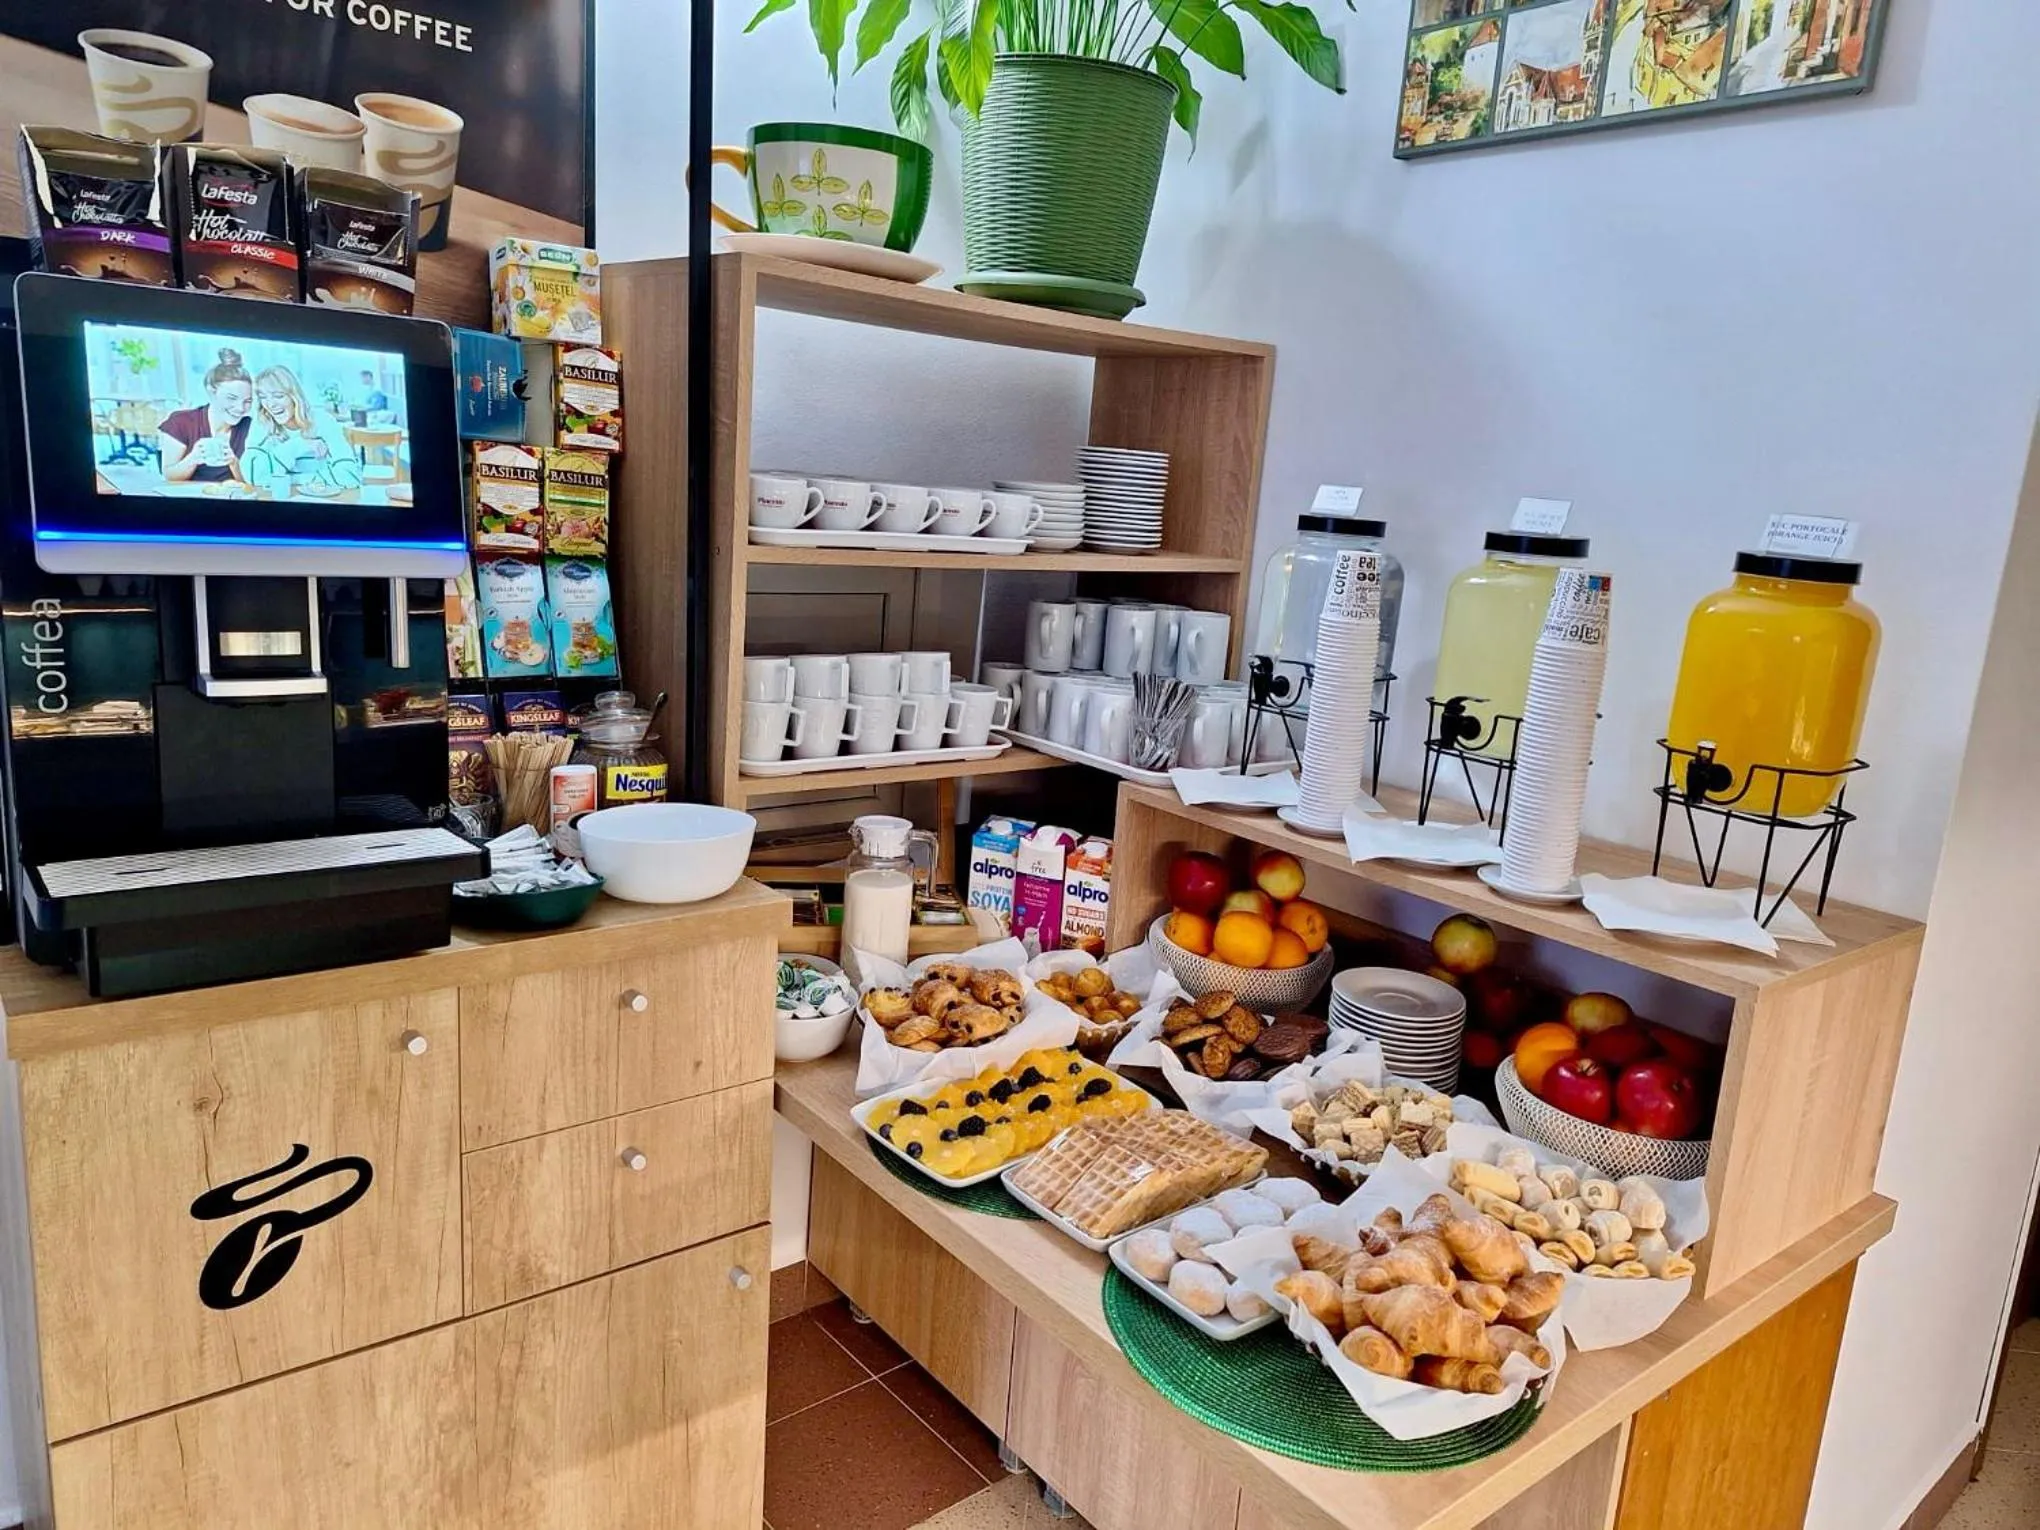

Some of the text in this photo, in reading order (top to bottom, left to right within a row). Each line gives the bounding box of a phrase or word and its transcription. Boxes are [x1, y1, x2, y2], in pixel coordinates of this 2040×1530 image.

[347, 0, 473, 52] COFFEE
[202, 184, 258, 205] LaFesta
[193, 209, 248, 231] Hot
[101, 230, 137, 244] DARK
[230, 244, 276, 260] CLASSIC
[565, 366, 617, 384] BASILUR
[481, 464, 538, 481] BASILUR
[550, 470, 604, 487] BASILUR
[1334, 554, 1351, 595] coffee
[21, 598, 69, 714] coffea
[448, 717, 486, 728] GSLEAF
[510, 713, 561, 725] KINGSLEAF
[615, 772, 668, 798] Nesqui
[973, 857, 1015, 880] alpro
[970, 889, 1011, 912] SOYA
[1066, 880, 1110, 903] alpro
[1064, 920, 1105, 938] ALMOND
